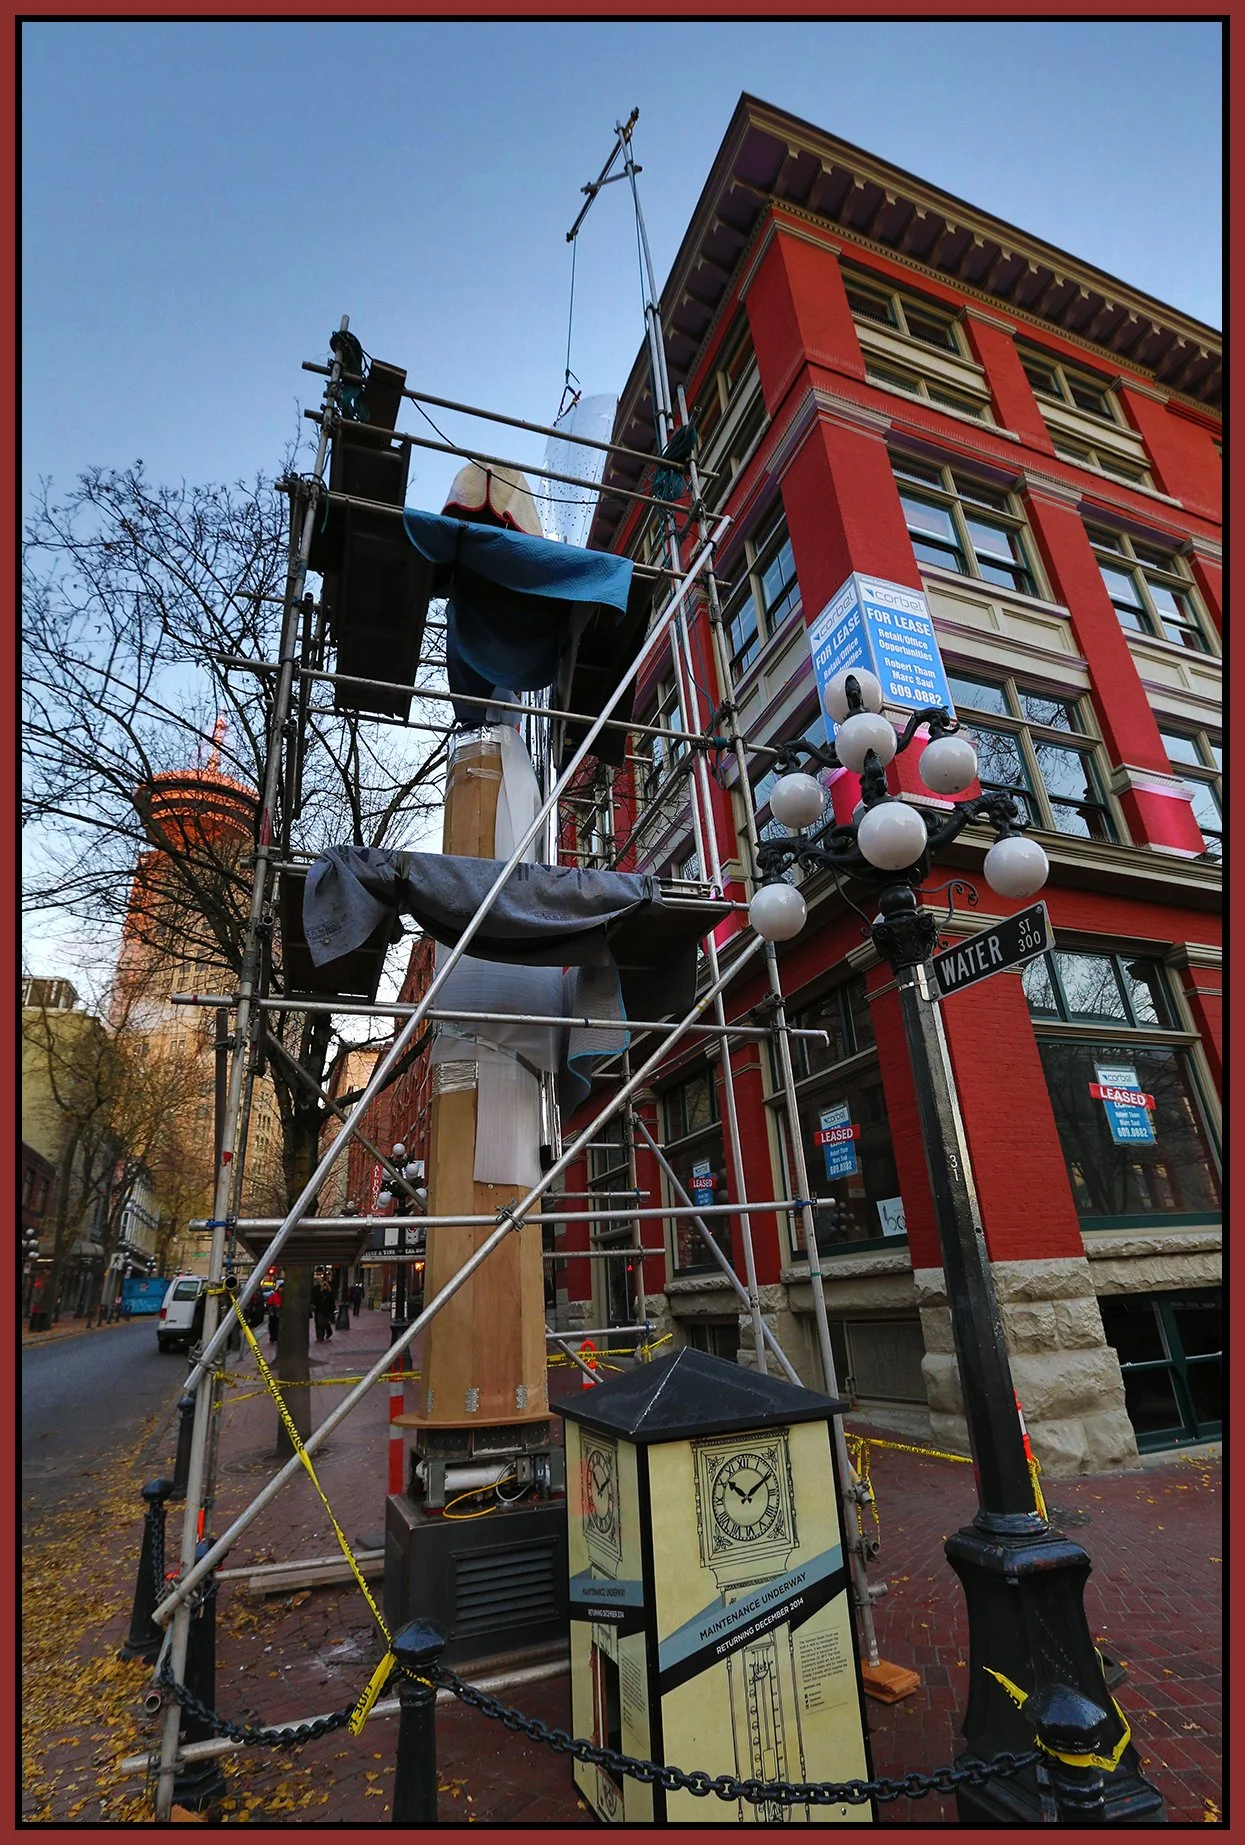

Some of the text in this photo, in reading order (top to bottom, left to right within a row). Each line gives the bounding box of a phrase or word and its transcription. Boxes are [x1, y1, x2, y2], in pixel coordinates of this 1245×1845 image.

[875, 591, 923, 612] corbel
[820, 591, 855, 637] corbel
[867, 607, 932, 637] FOR LEASE
[816, 643, 832, 670] FOR
[833, 610, 861, 651] LEASE
[878, 629, 928, 650] Retail/Office
[879, 640, 933, 662] Opportunities
[884, 657, 936, 679] Robert Tham
[892, 670, 934, 689] Marc Saul
[889, 682, 944, 707] 609.0882
[941, 918, 1031, 986] WATER ST
[1018, 930, 1041, 952] 300
[1100, 1087, 1146, 1106] LEASED
[821, 1128, 853, 1143] LEASED
[693, 1179, 713, 1188] LEASED
[700, 1572, 807, 1641] MAINTENANCE UNDERWAY
[716, 1597, 804, 1655] RETURNING DECEMBER 2014
